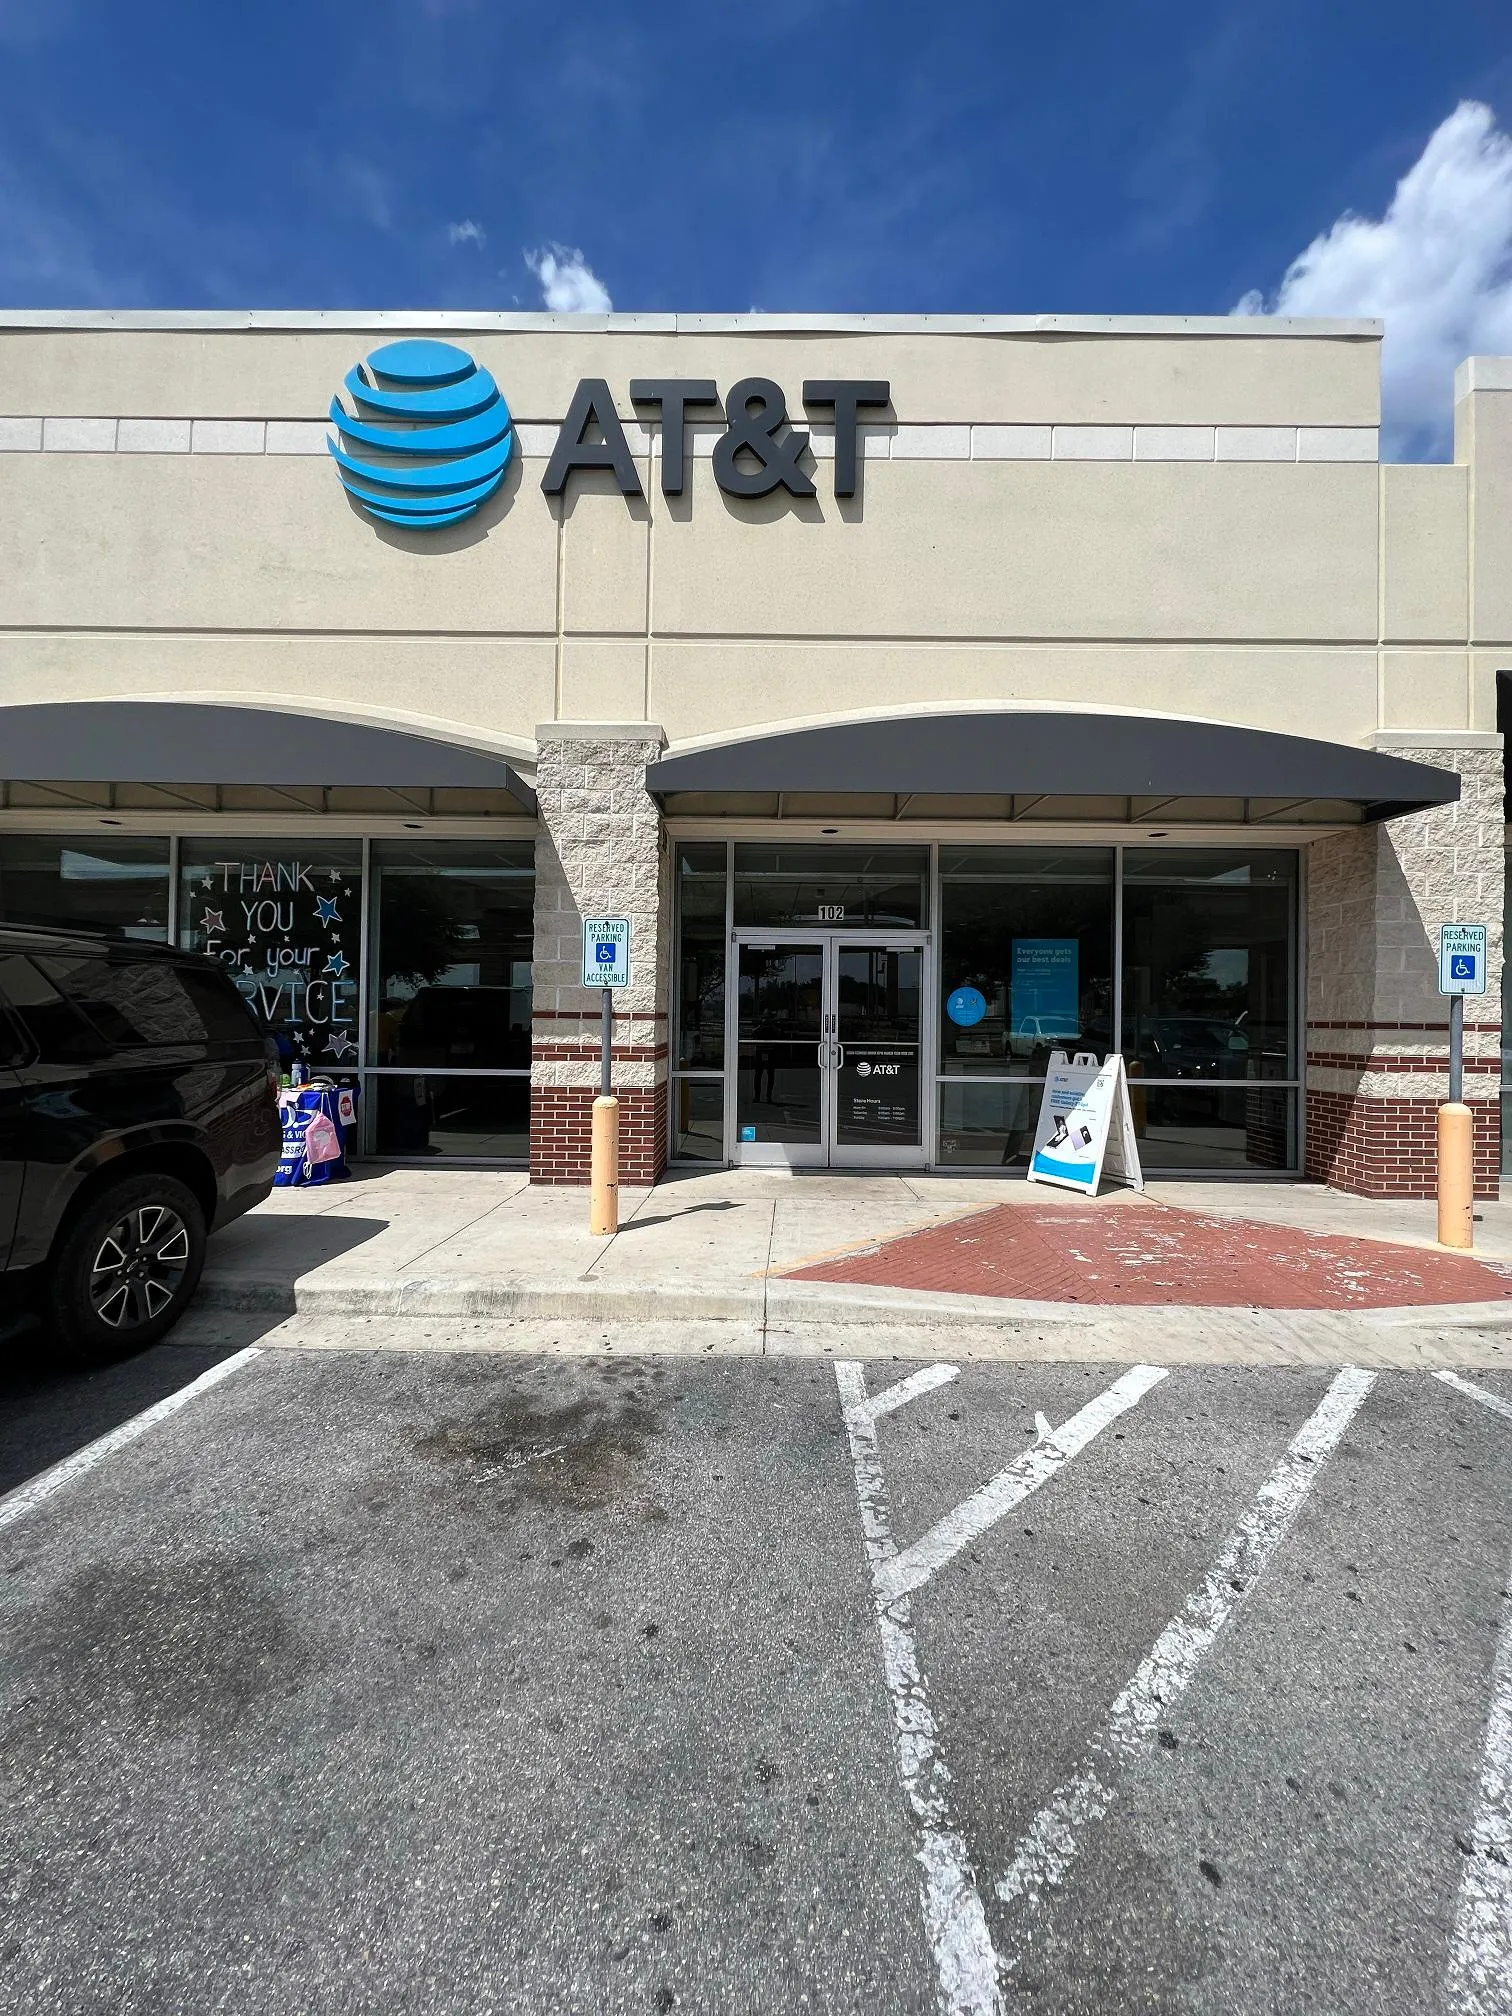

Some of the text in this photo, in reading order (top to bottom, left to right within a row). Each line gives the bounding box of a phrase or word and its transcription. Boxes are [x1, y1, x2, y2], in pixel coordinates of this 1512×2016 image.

[540, 377, 890, 498] AT&T
[214, 861, 315, 893] THANK
[241, 900, 294, 931] YOU
[820, 906, 843, 920] 102
[588, 923, 625, 933] RESERVED
[591, 933, 622, 943] PARKING
[1443, 930, 1484, 941] RESERVED
[1017, 947, 1072, 957] Everyone gets
[1446, 942, 1481, 953] PARKING
[203, 940, 320, 977] For your
[1017, 956, 1030, 964] our
[1032, 956, 1049, 964] best
[598, 963, 614, 972] VAN
[586, 973, 625, 983] ACCESSIBLE
[236, 980, 355, 1024] RVICE
[872, 1064, 901, 1075] AT&T
